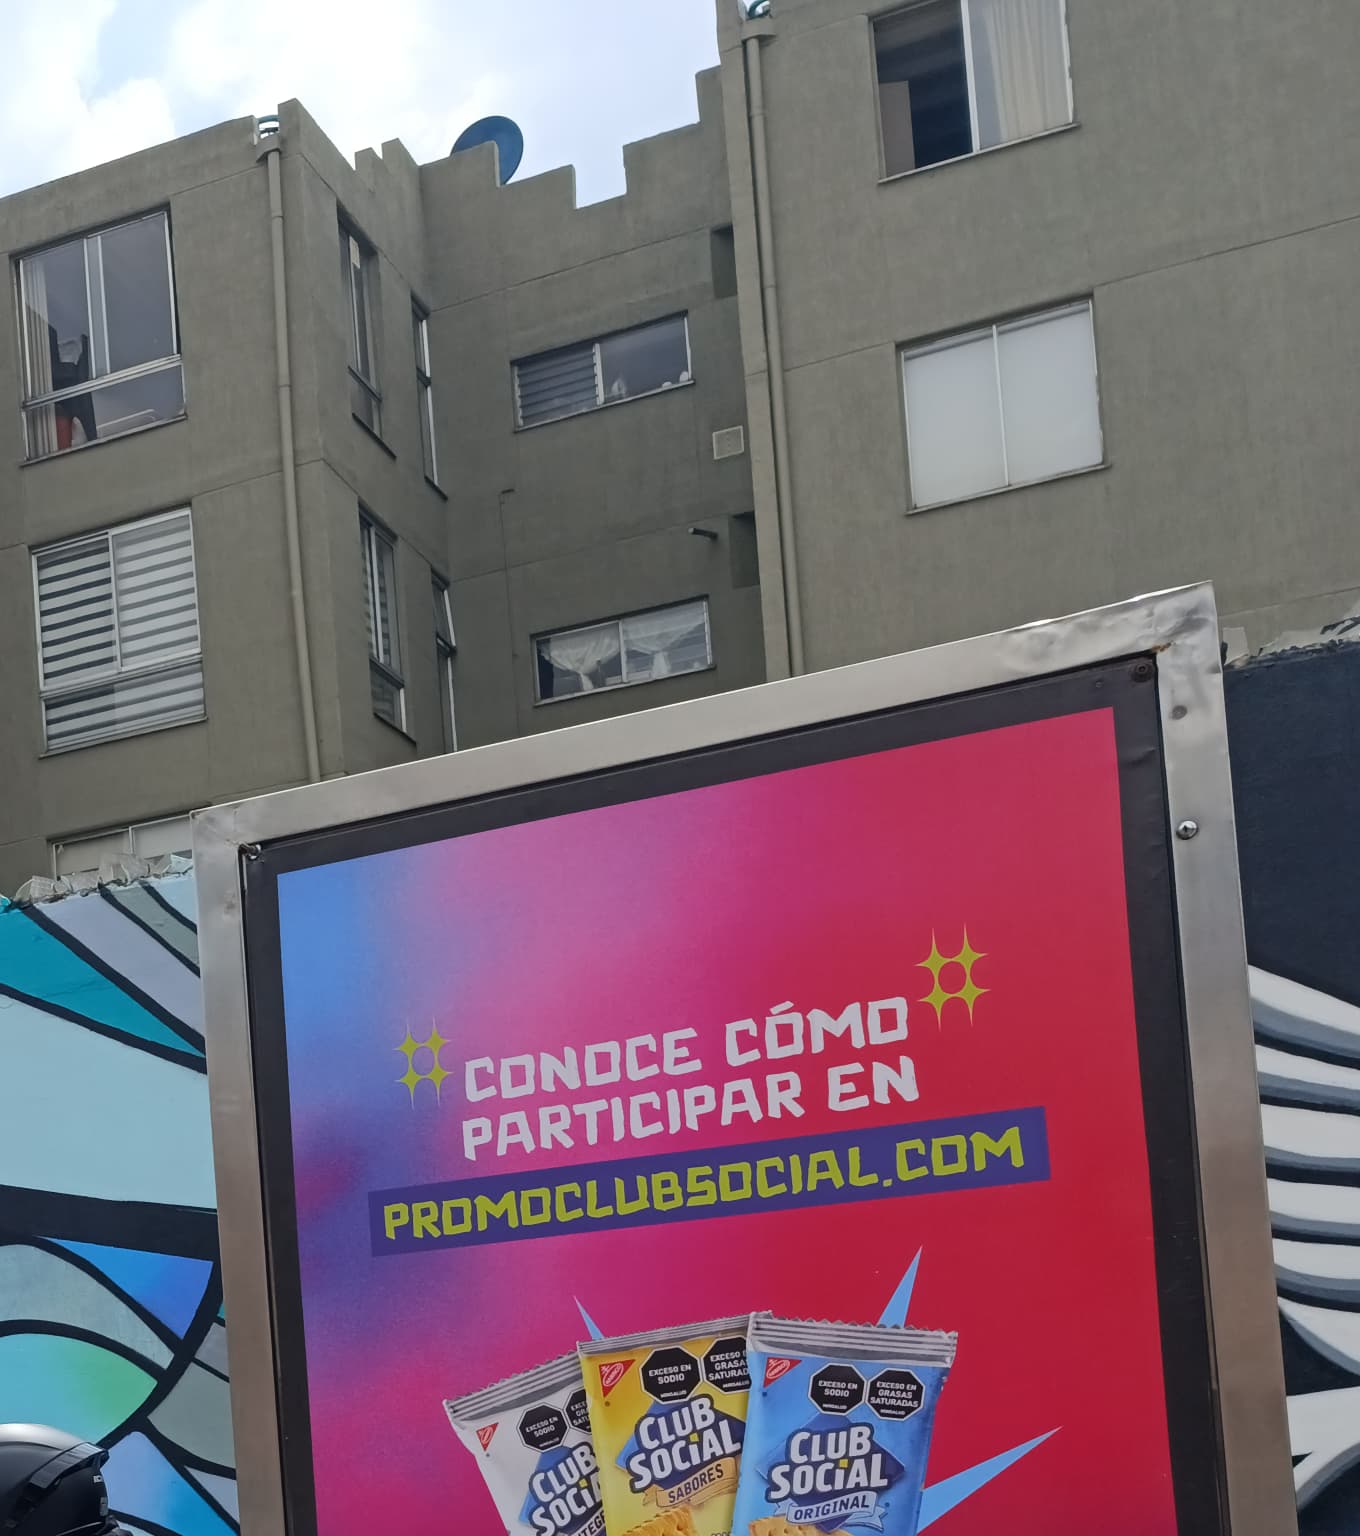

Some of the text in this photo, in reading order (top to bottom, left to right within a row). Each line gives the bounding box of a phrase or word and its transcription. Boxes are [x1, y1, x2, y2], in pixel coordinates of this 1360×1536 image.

[464, 995, 909, 1103] CONOCE CÓMO
[461, 1055, 921, 1162] PARTICIPAR EN
[383, 1126, 1025, 1241] PROMOCLUBSOCIAL.COM
[657, 1373, 685, 1385] SODIO
[708, 1368, 749, 1381] SATURAD
[714, 1359, 747, 1371] GRASA
[824, 1388, 849, 1397] SODIO
[870, 1397, 919, 1408] SATURADAS
[878, 1390, 913, 1399] GRASAS
[639, 1397, 716, 1450] CLUB
[790, 1426, 871, 1463] CLUB
[532, 1445, 598, 1503] CLUB
[668, 1463, 724, 1504] SABORES
[794, 1495, 870, 1521] ORIGINAL
